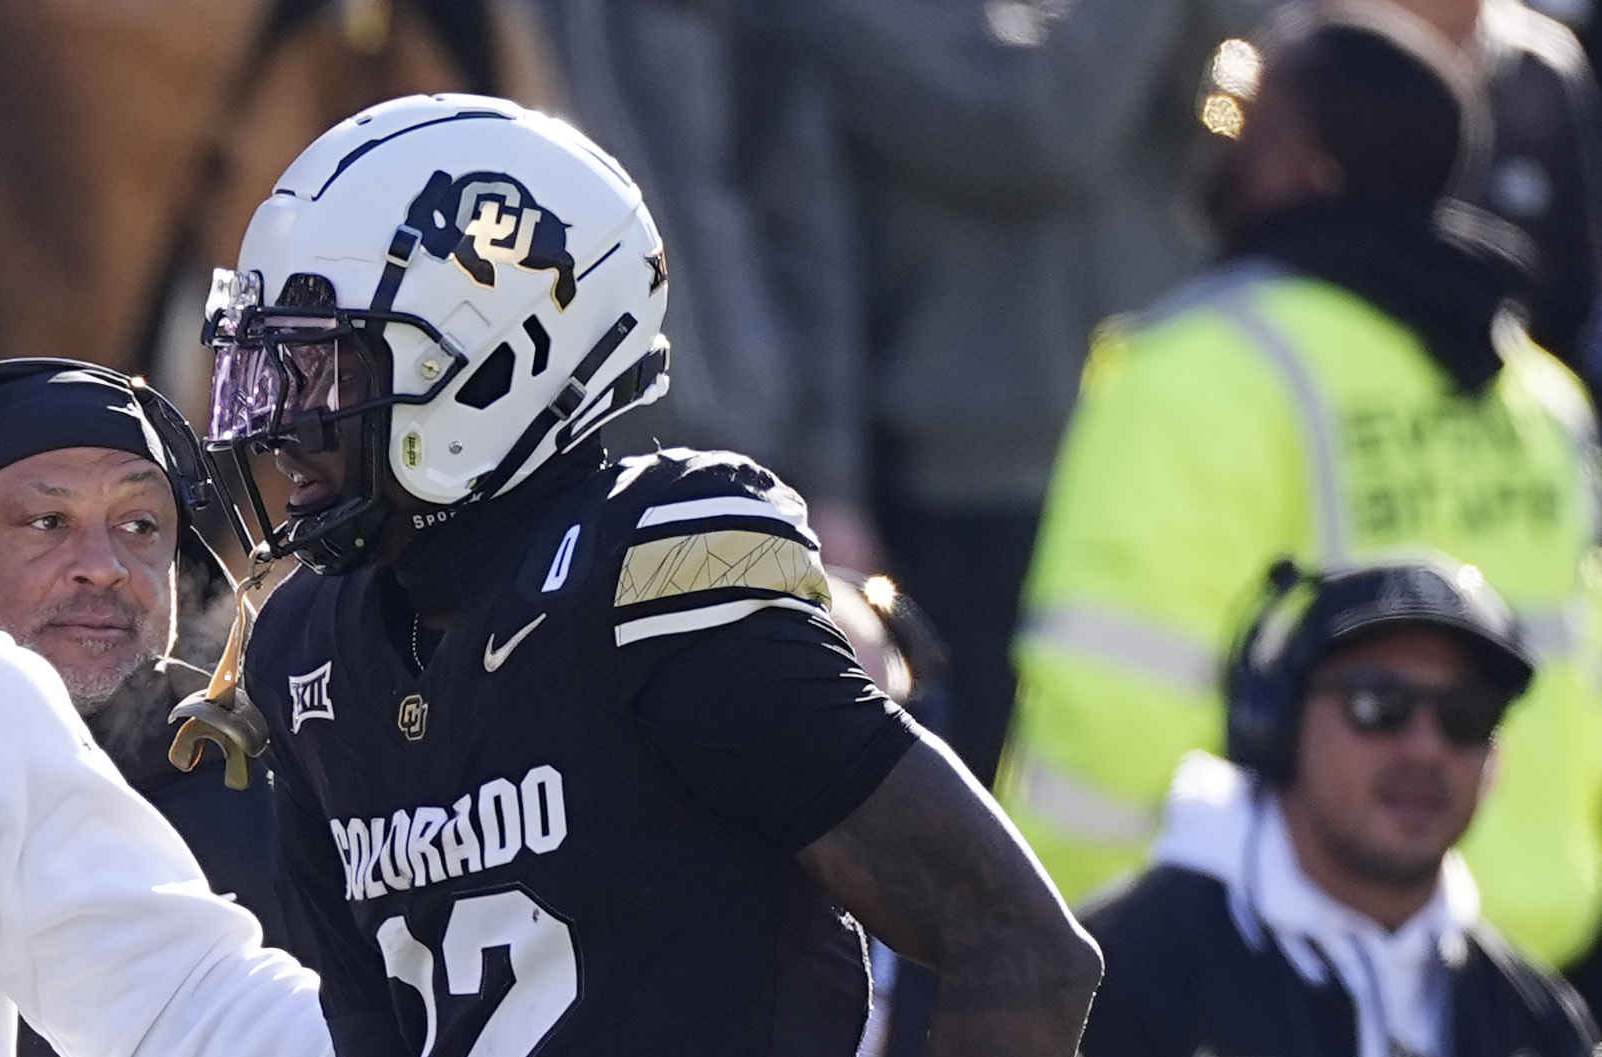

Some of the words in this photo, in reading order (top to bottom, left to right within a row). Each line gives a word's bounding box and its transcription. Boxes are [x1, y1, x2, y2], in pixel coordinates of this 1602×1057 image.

[455, 181, 543, 264] CU
[398, 693, 429, 741] CU
[329, 764, 568, 901] COLORADO
